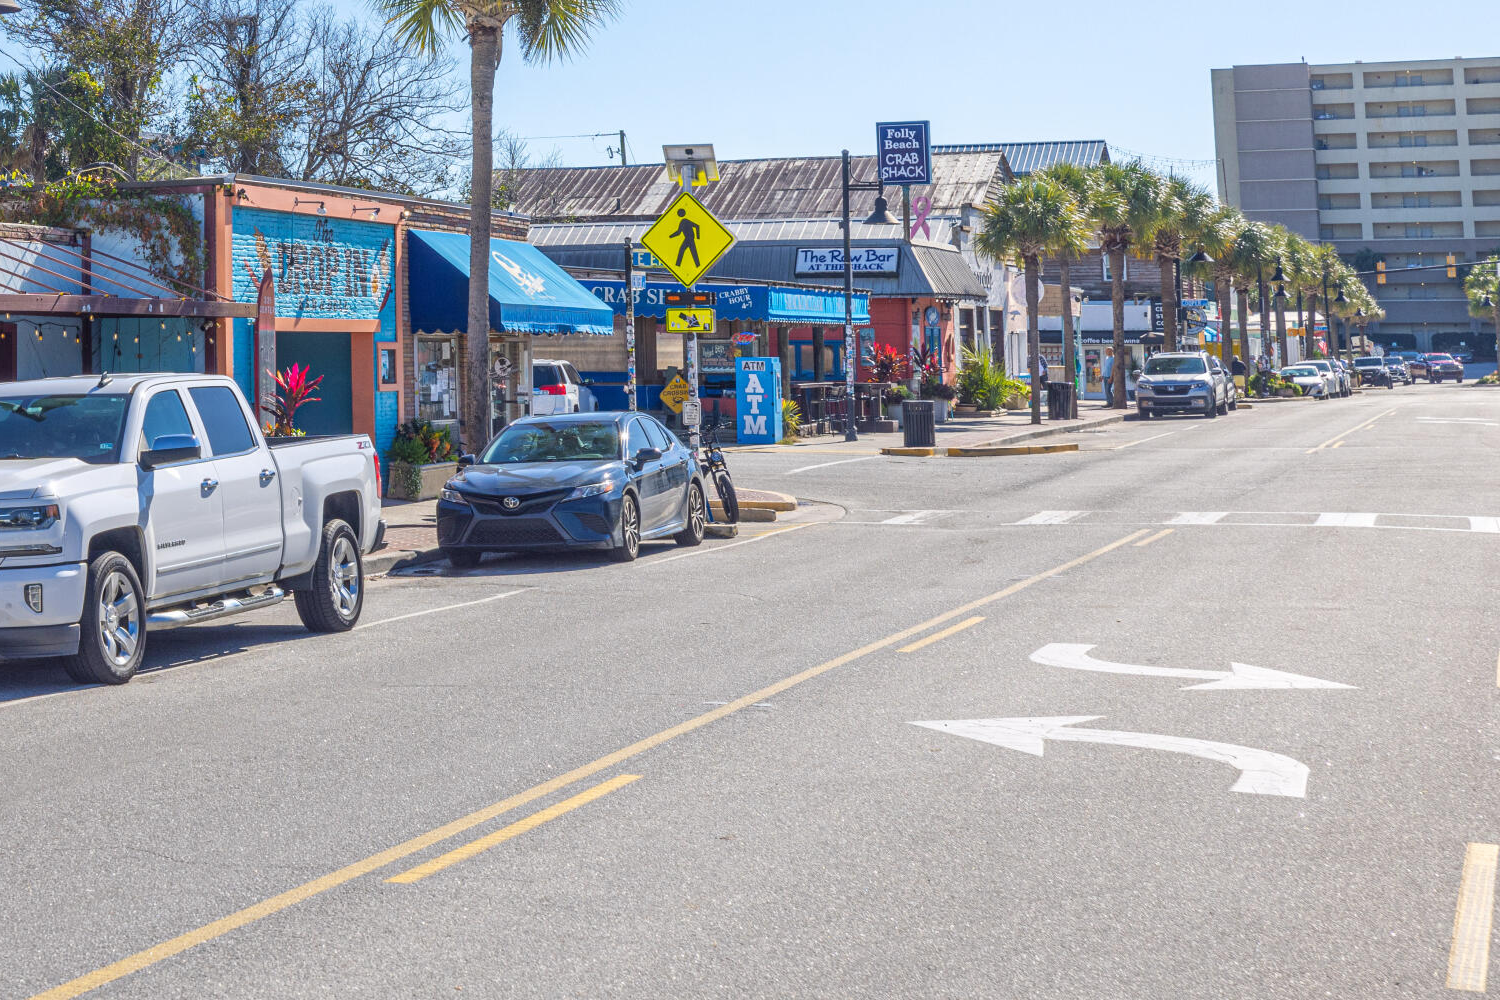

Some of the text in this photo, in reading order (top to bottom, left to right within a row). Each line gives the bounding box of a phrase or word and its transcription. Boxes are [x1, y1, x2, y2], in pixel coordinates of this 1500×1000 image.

[886, 128, 917, 140] Folly
[884, 139, 920, 150] Beach
[885, 152, 919, 165] CRAB
[882, 165, 925, 178] SHACK
[313, 219, 334, 243] The
[801, 250, 826, 262] The
[865, 249, 894, 262] Bar
[277, 242, 368, 297] DROP IN
[591, 286, 640, 304] CRAB
[719, 287, 749, 299] CRABBY
[729, 295, 751, 304] HOUR
[743, 361, 765, 371] ATM
[743, 373, 767, 435] ATM
